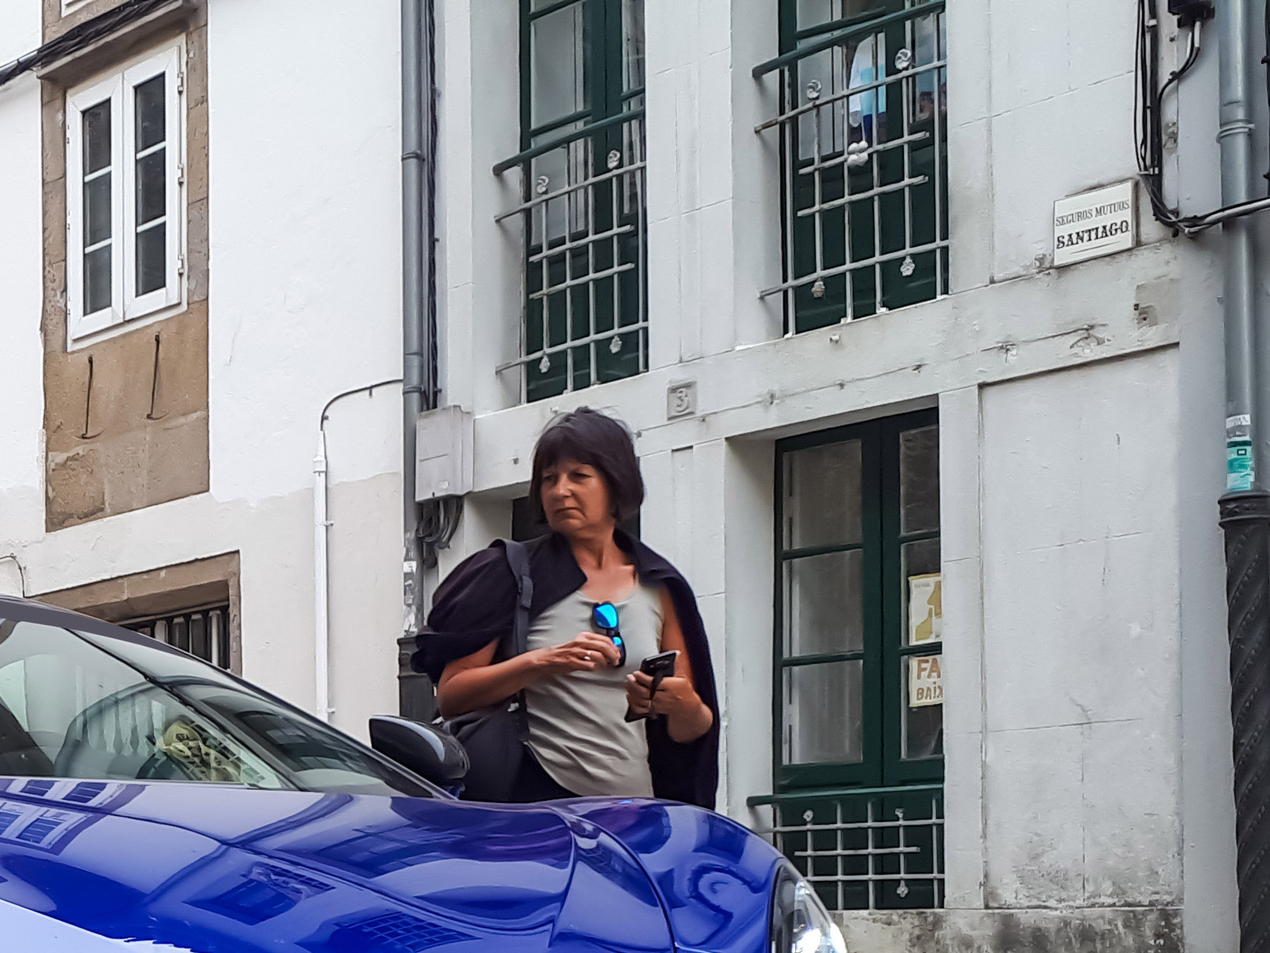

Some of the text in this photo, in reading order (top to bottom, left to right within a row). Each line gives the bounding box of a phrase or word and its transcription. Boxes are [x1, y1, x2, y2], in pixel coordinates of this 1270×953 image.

[1055, 199, 1130, 227] SEGUROS MUTUOS
[1055, 220, 1130, 250] SANTIAGO
